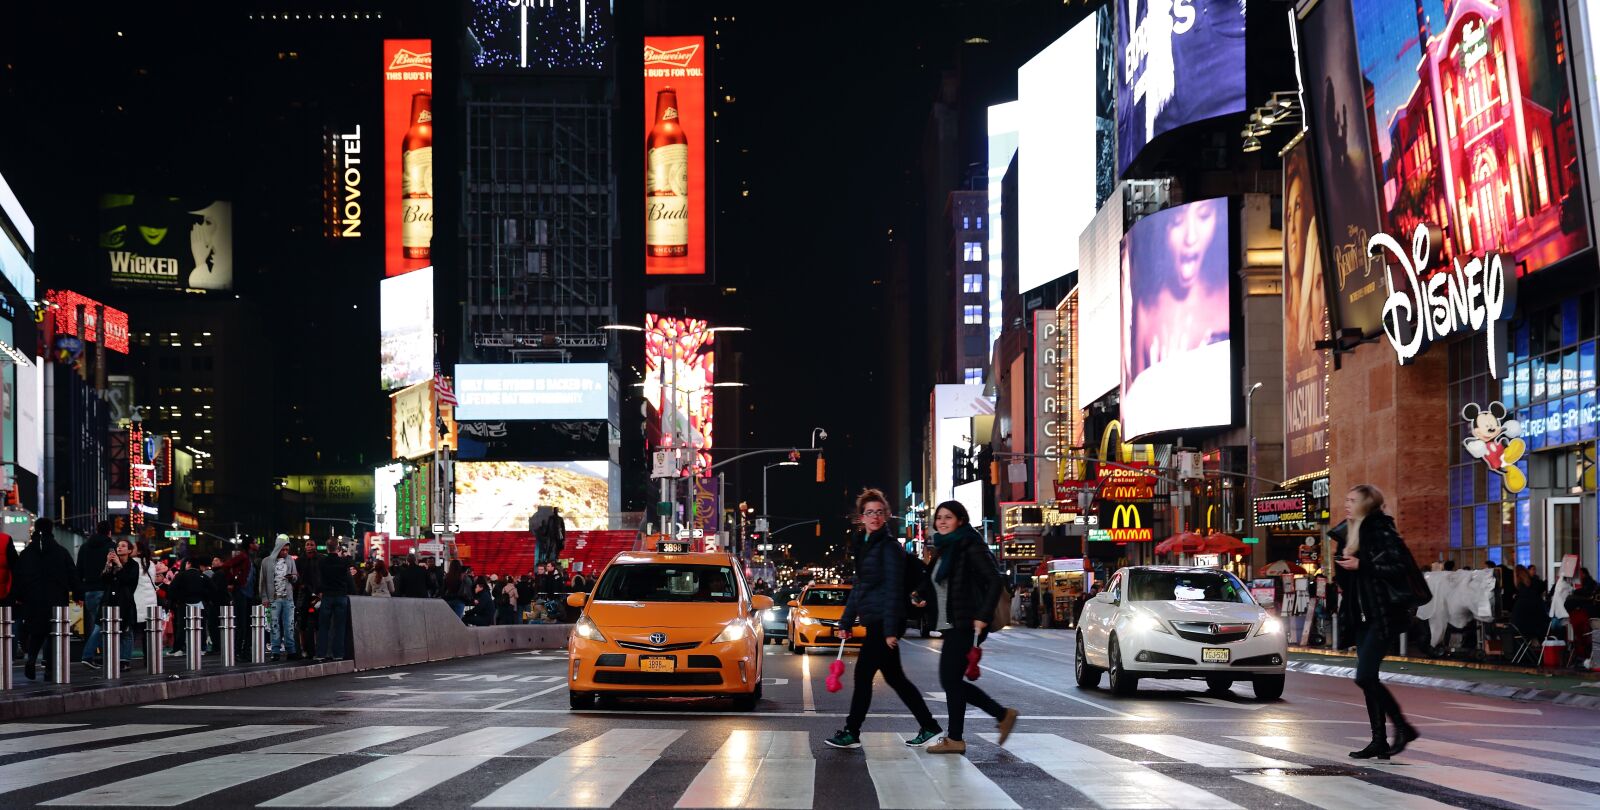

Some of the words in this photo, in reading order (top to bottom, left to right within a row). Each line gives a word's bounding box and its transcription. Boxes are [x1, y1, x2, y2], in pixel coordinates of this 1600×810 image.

[387, 71, 402, 80] THIS
[403, 71, 425, 80] BUD'S
[648, 69, 670, 77] BUD'S
[671, 69, 685, 77] FOR
[686, 68, 703, 77] YOU.
[342, 124, 361, 237] NOVOTEL
[109, 251, 179, 276] WICKED
[1044, 323, 1057, 461] PALACE
[1258, 498, 1303, 512] ELECTRONICS
[663, 543, 682, 552] 3B98
